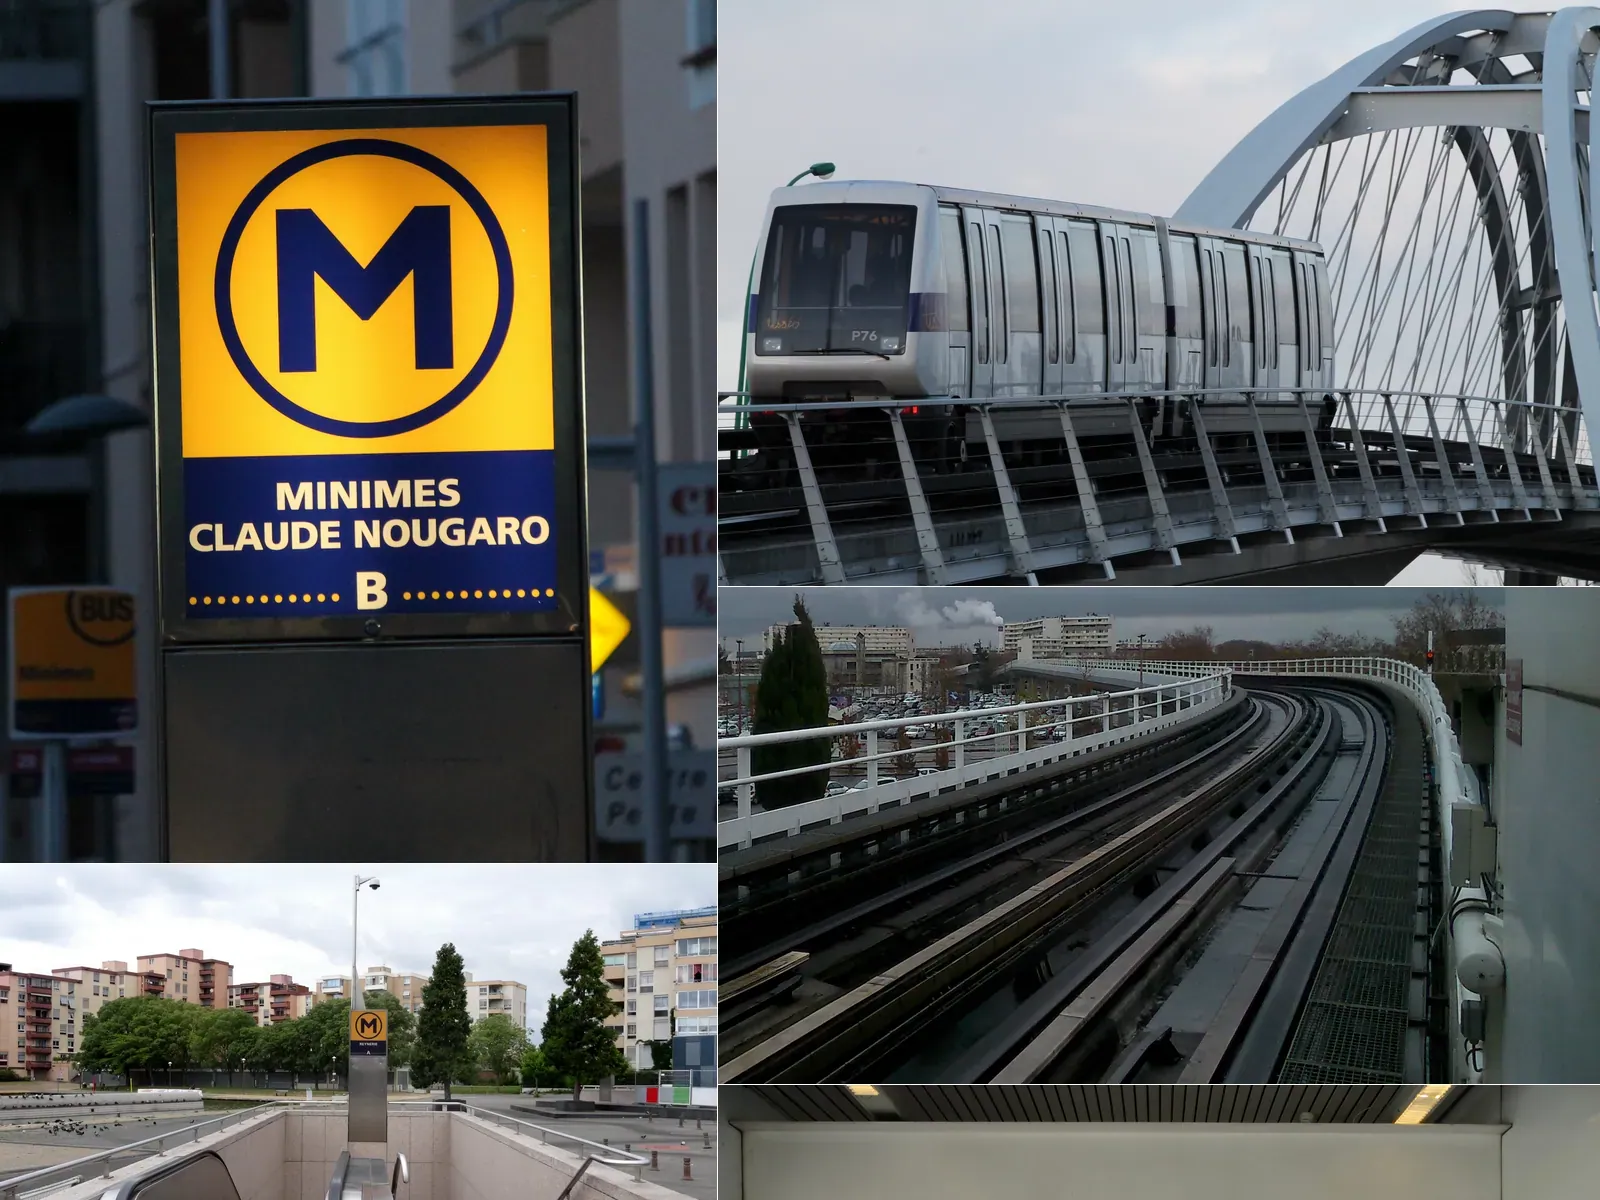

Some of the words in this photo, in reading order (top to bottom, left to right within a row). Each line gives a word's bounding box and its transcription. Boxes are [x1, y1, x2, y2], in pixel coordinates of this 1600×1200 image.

[275, 205, 454, 373] M
[851, 330, 878, 342] P76
[275, 478, 462, 511] MINIMES
[188, 521, 342, 552] CLAUDE
[354, 515, 551, 548] NOUGARO
[355, 571, 389, 611] B
[79, 594, 134, 622] BUS
[360, 1017, 378, 1034] M
